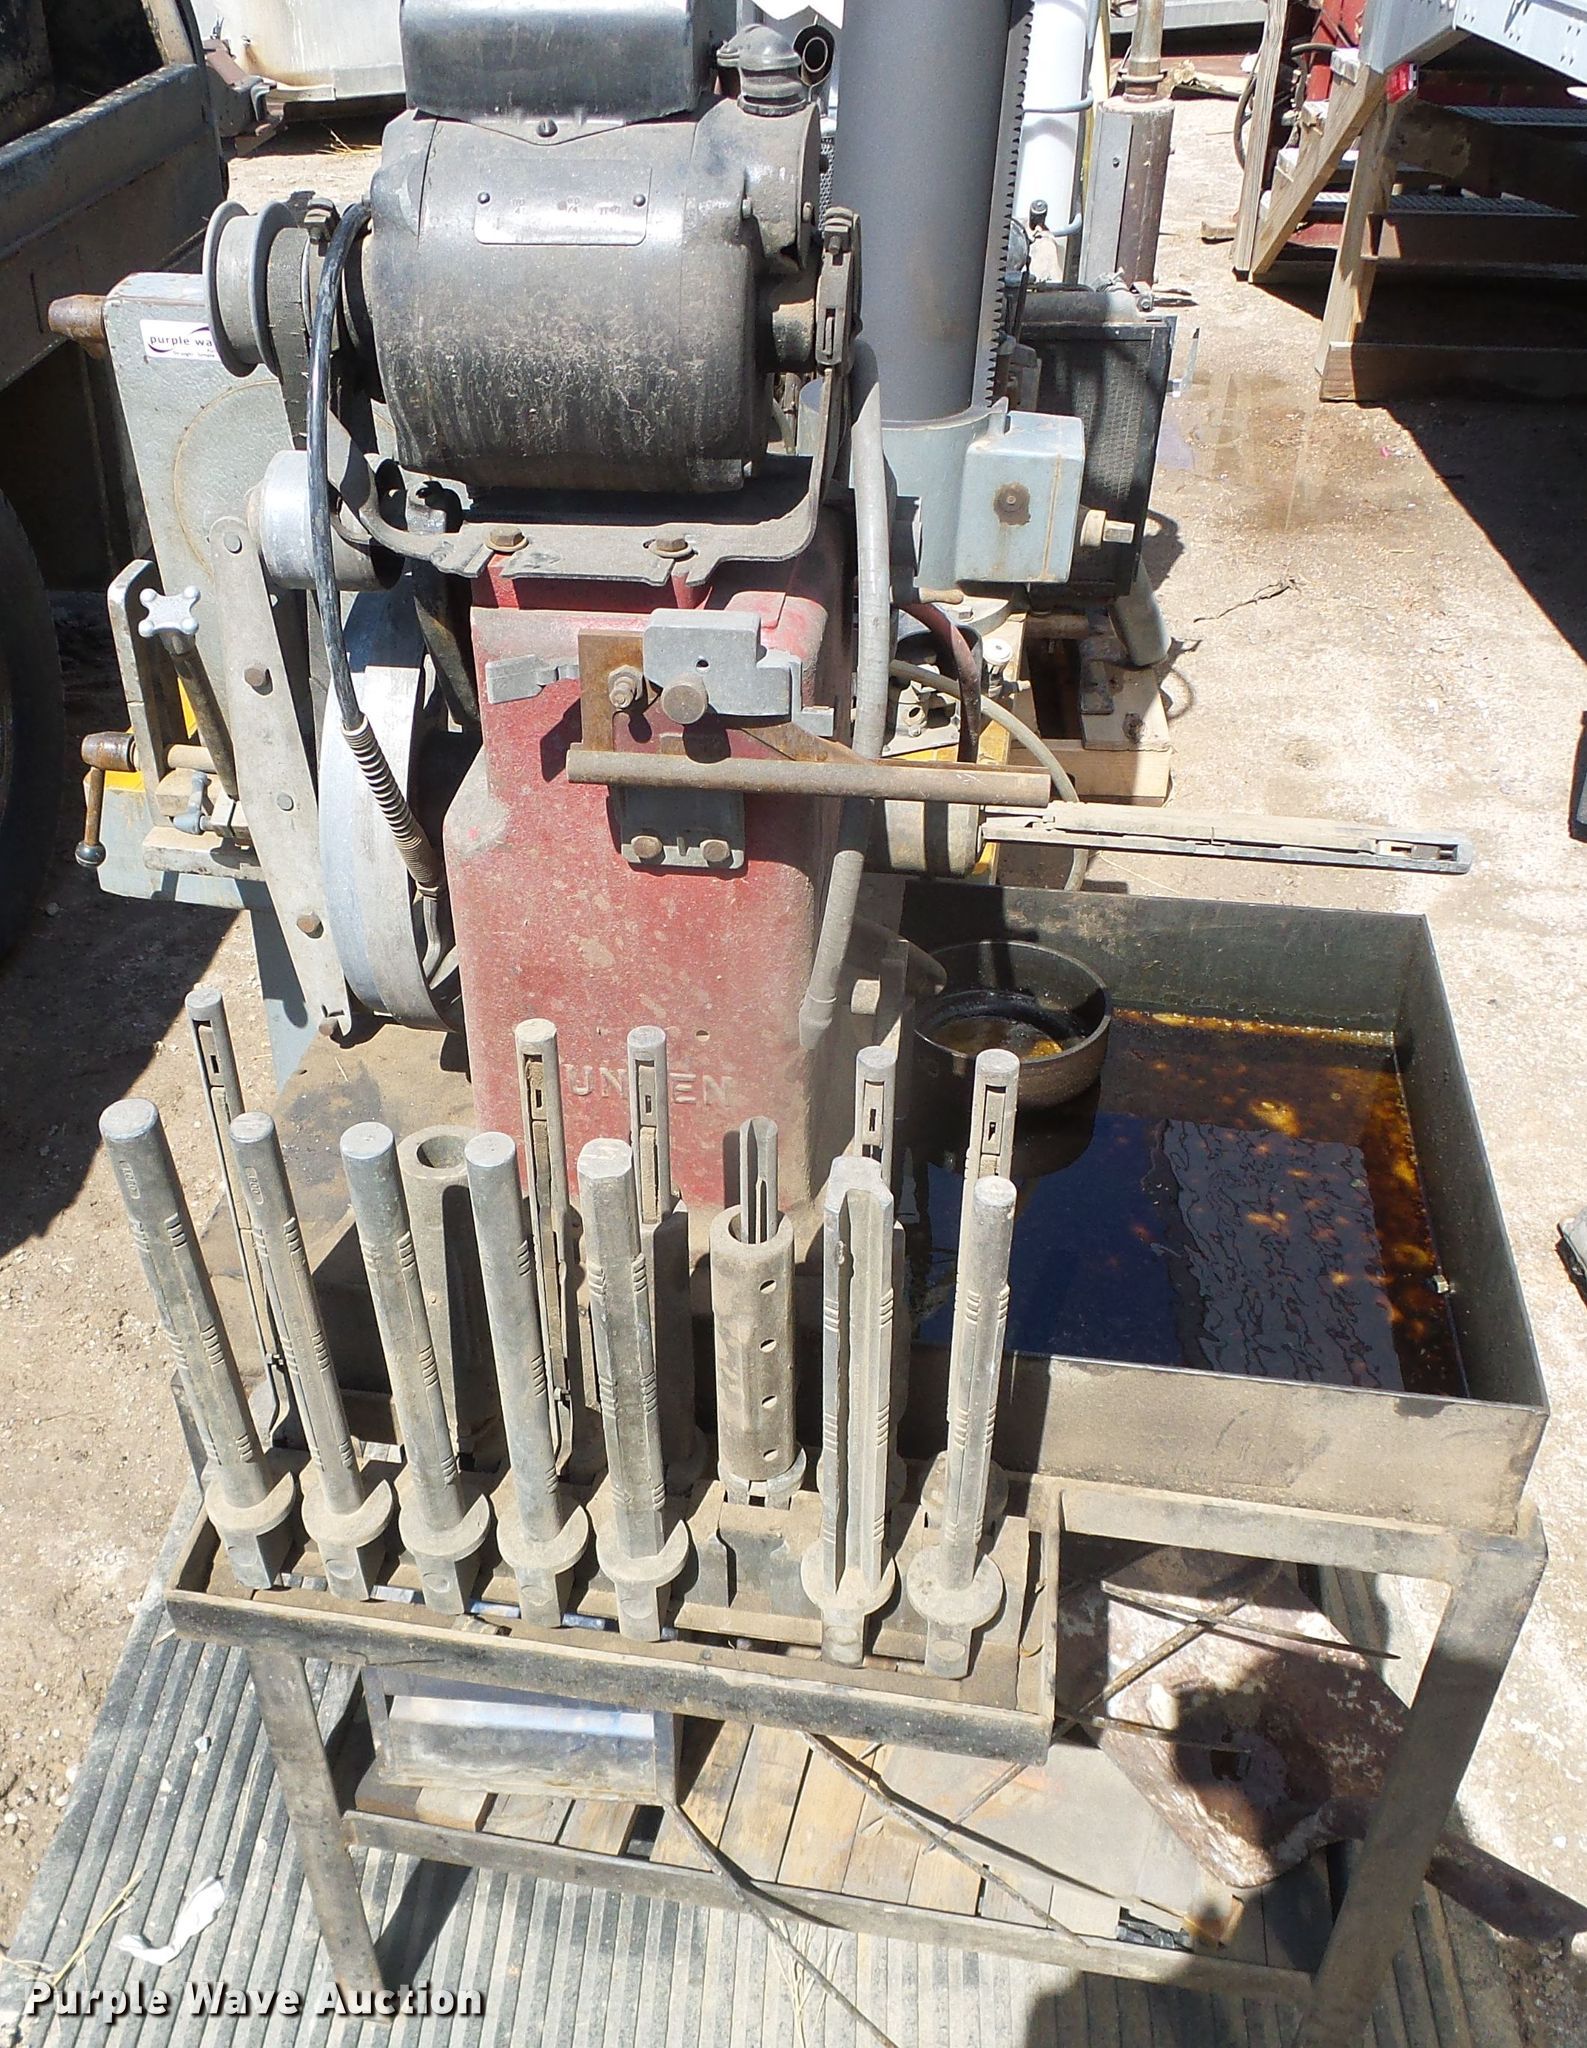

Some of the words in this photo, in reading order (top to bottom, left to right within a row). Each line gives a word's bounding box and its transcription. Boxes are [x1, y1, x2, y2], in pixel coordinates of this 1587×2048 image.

[150, 336, 190, 346] purple
[195, 339, 213, 347] wa
[562, 1062, 734, 1108] UNEN
